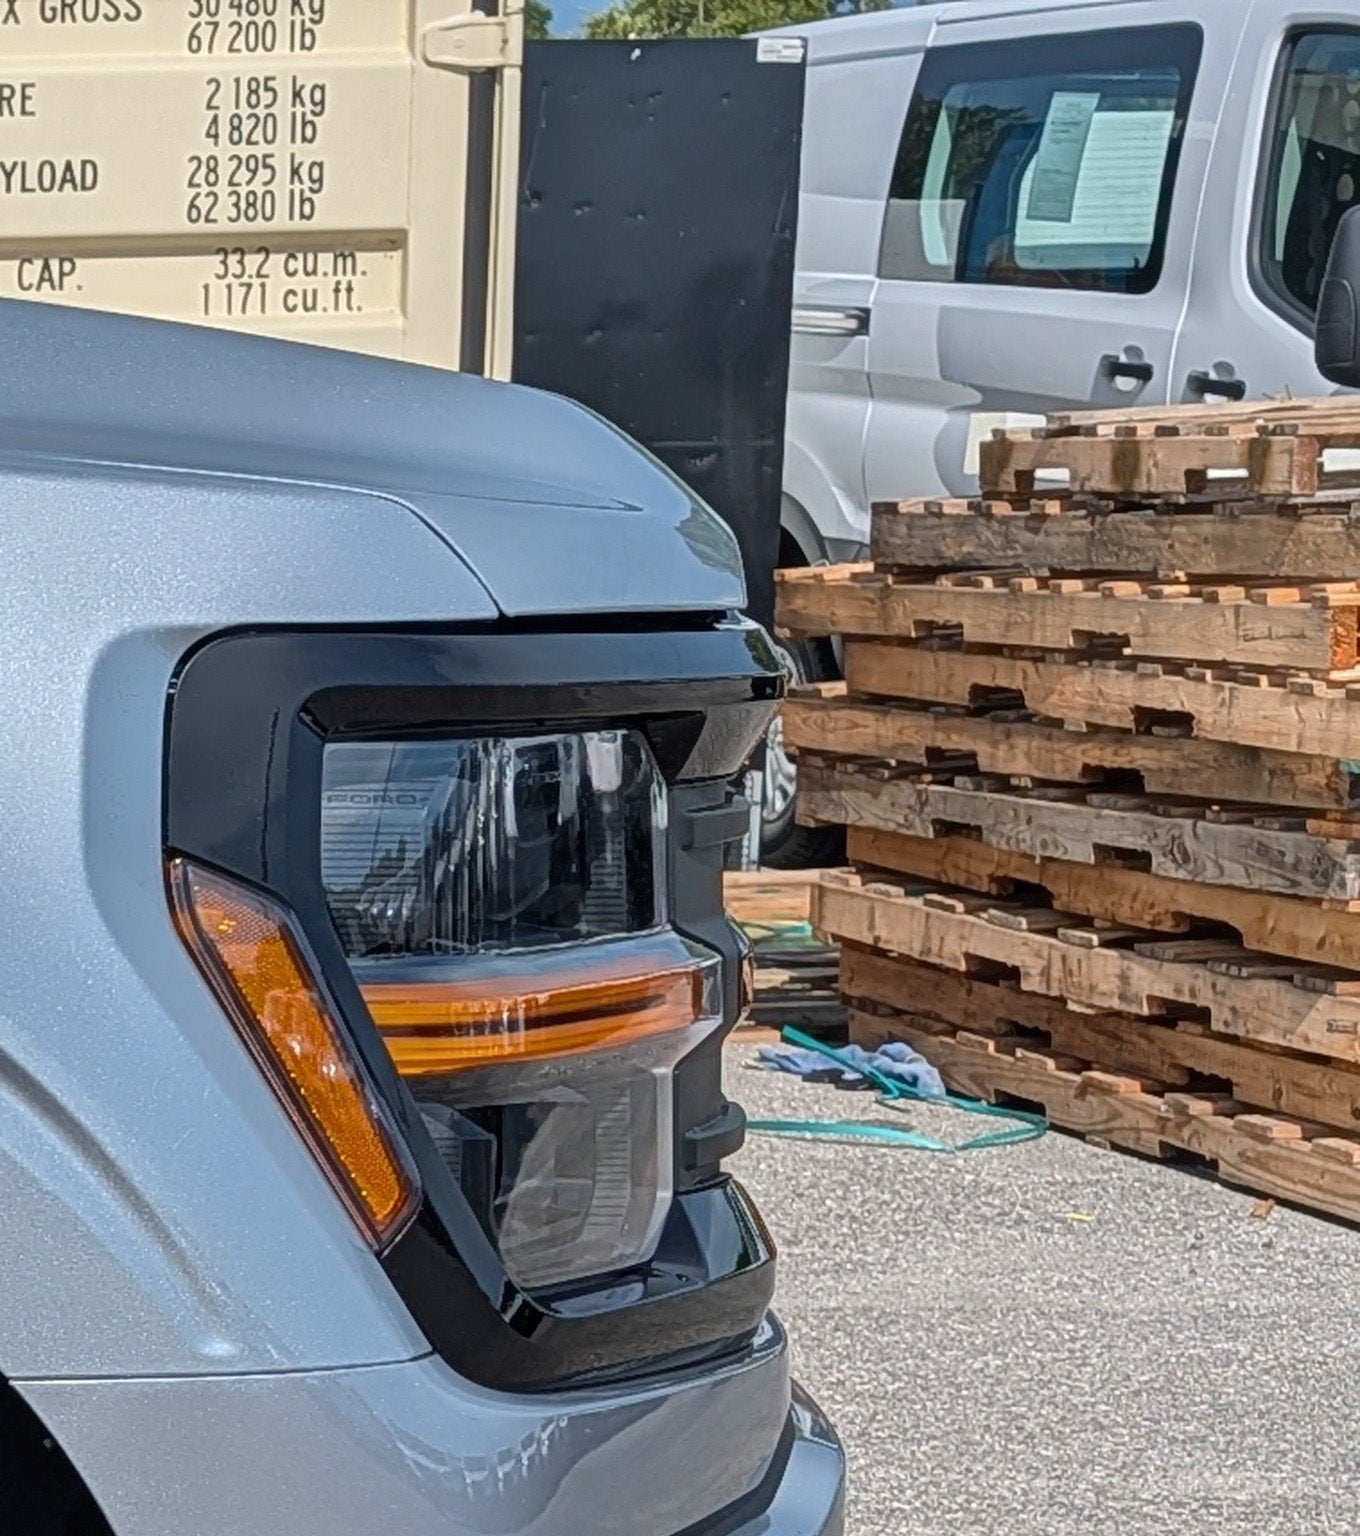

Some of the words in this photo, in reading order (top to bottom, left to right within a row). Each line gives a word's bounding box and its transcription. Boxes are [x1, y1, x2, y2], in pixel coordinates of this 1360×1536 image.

[39, 0, 143, 24] GROSS
[187, 20, 220, 54] 67
[227, 19, 277, 53] 200
[289, 18, 317, 52] lb
[232, 75, 278, 110] 185
[290, 74, 326, 117] kg
[228, 112, 278, 146] 820
[289, 110, 318, 145] lb
[186, 155, 220, 189] 28
[227, 153, 277, 188] 295
[288, 152, 325, 195] kg
[186, 191, 220, 224] 62
[226, 189, 277, 224] 380
[287, 187, 316, 222] lb
[17, 256, 84, 292] CAP.
[214, 246, 271, 280] 33.2
[283, 279, 363, 313] cu.ft.
